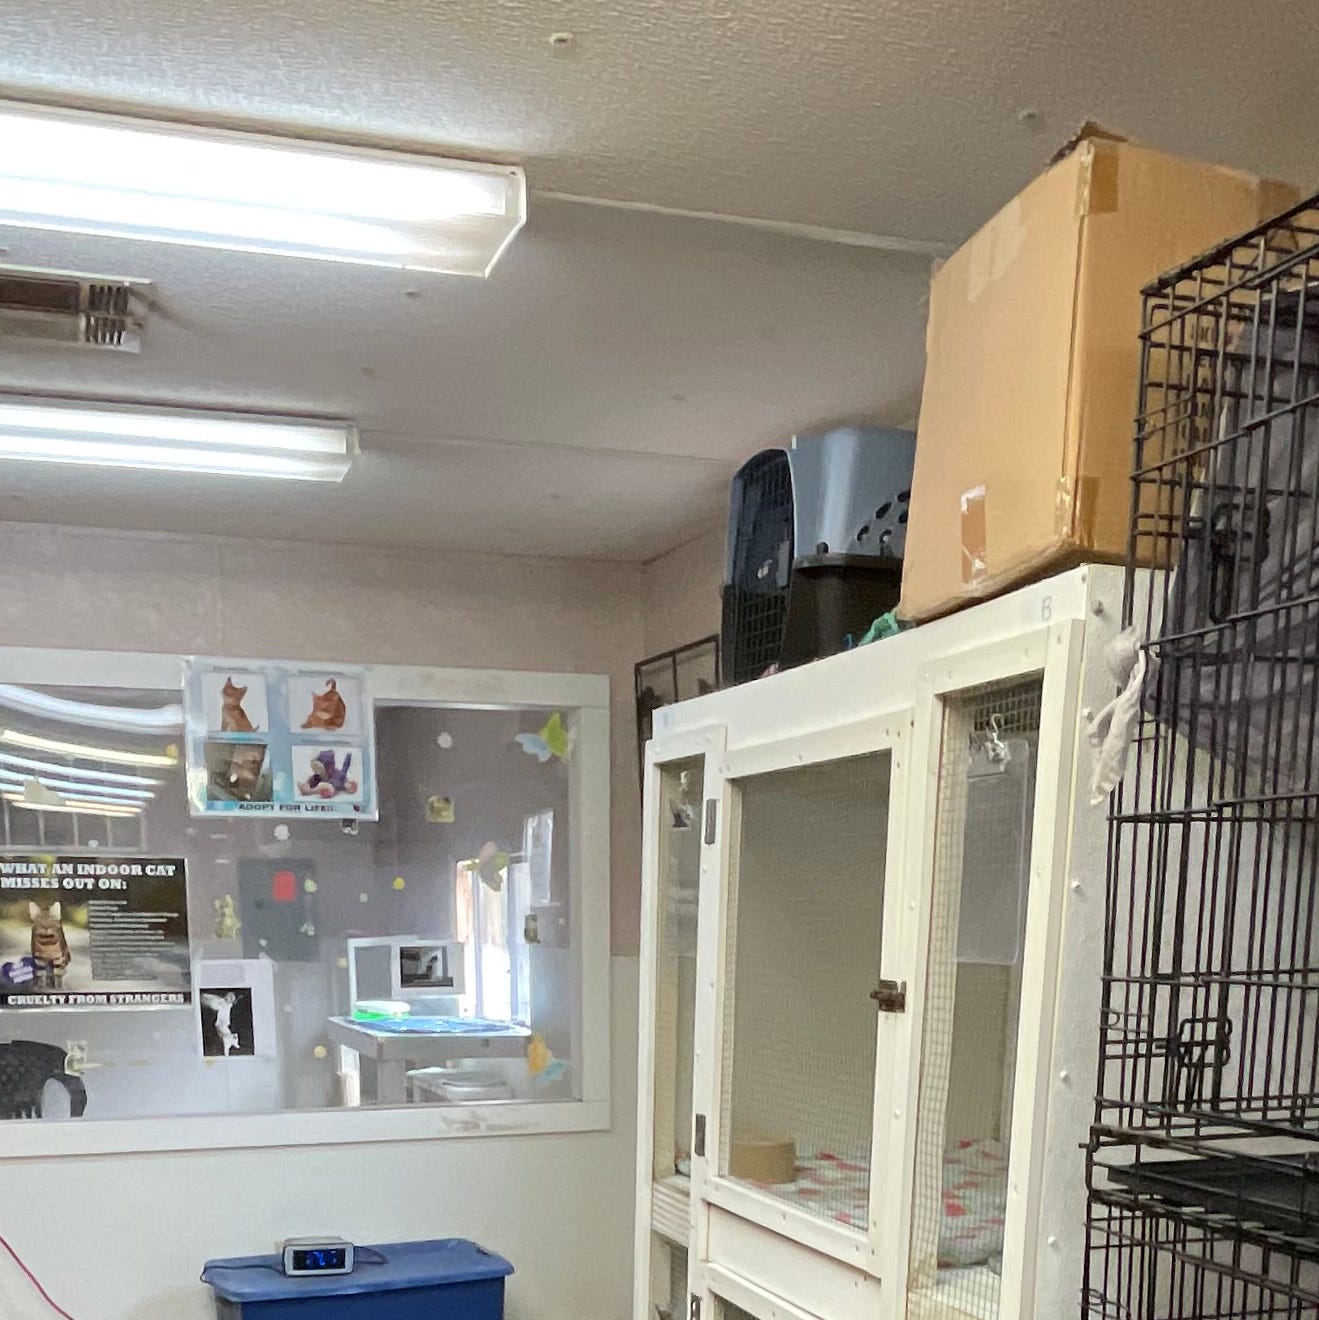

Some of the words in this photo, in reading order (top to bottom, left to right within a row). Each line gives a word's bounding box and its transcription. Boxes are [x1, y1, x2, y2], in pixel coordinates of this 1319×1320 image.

[238, 803, 275, 812] ADOPT
[279, 803, 301, 812] FOR
[0, 863, 47, 875] WHAT
[51, 863, 74, 875] AN
[77, 864, 143, 876] INDOOR
[145, 864, 176, 877] CAT
[0, 878, 59, 889] MISSES
[62, 878, 95, 890] OUT
[98, 878, 128, 890] ON:
[7, 994, 66, 1006] CRUELTY
[68, 994, 107, 1005] FROM
[109, 993, 185, 1005] STRANGERS
